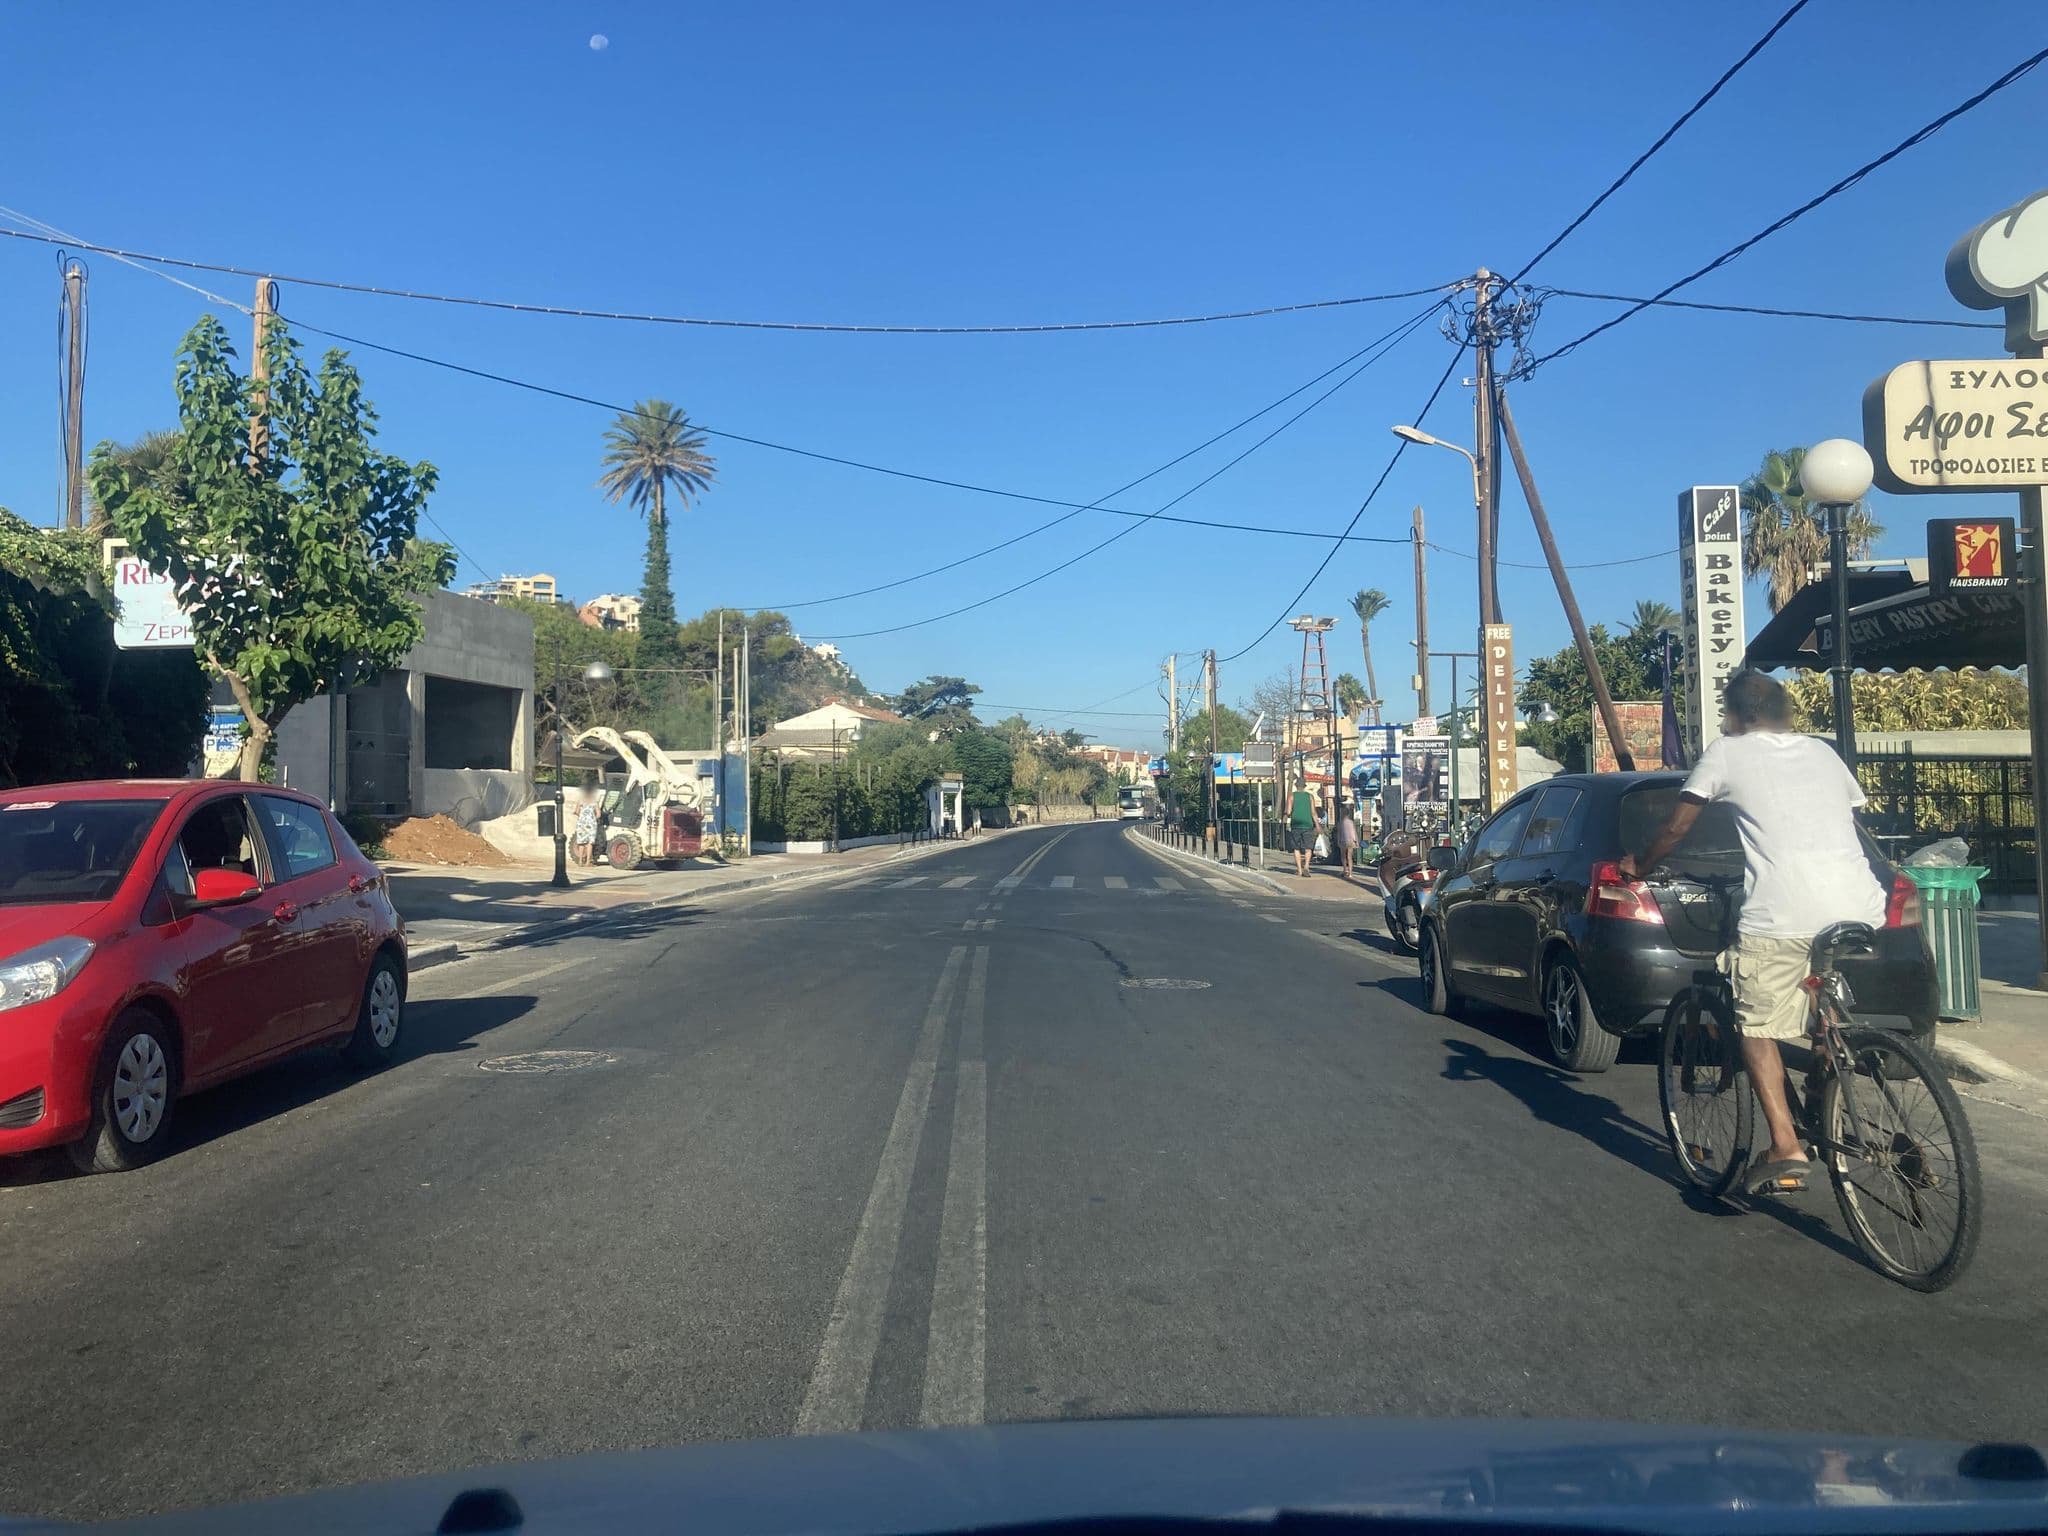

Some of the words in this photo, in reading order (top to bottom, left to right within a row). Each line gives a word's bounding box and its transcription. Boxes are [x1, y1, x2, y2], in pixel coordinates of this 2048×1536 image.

[1910, 457, 2036, 475] ΤΡΟΦΟΔΟΣΙΕΣ
[1703, 491, 1732, 533] Café
[1704, 532, 1731, 542] point
[1949, 577, 2009, 587] HAUSBRANDT
[1704, 554, 1736, 653] Bakery
[1487, 627, 1511, 640] FREE
[1492, 646, 1511, 790] DELIVERY
